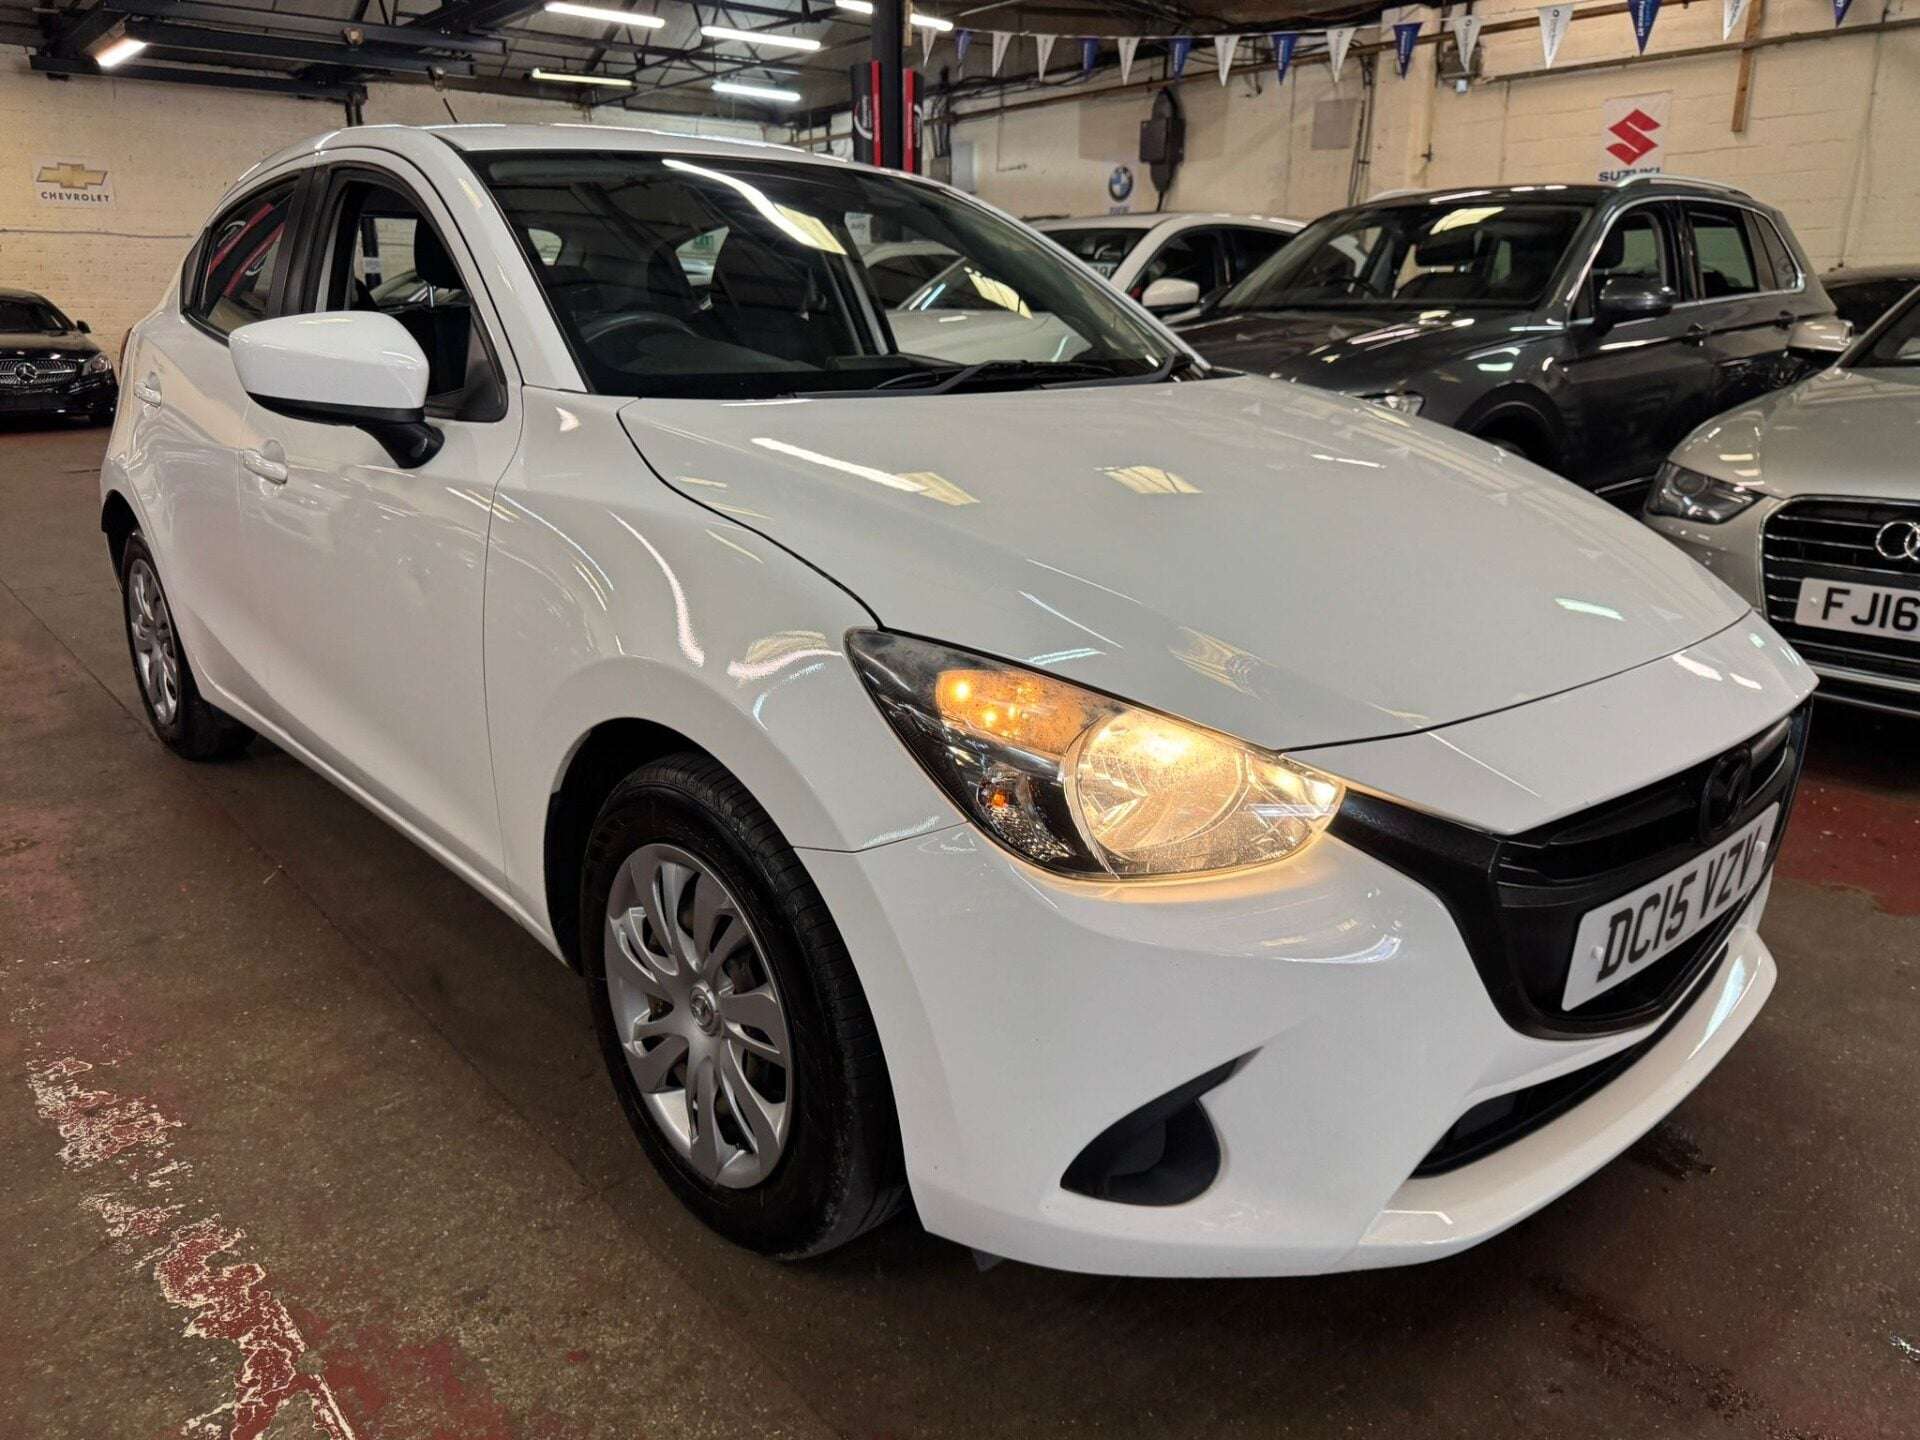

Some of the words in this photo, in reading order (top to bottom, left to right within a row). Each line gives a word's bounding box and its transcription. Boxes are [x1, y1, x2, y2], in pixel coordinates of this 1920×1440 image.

[41, 191, 109, 202] CHEVROLET
[1821, 587, 1920, 632] FJ16
[1596, 870, 1698, 983] DC15
